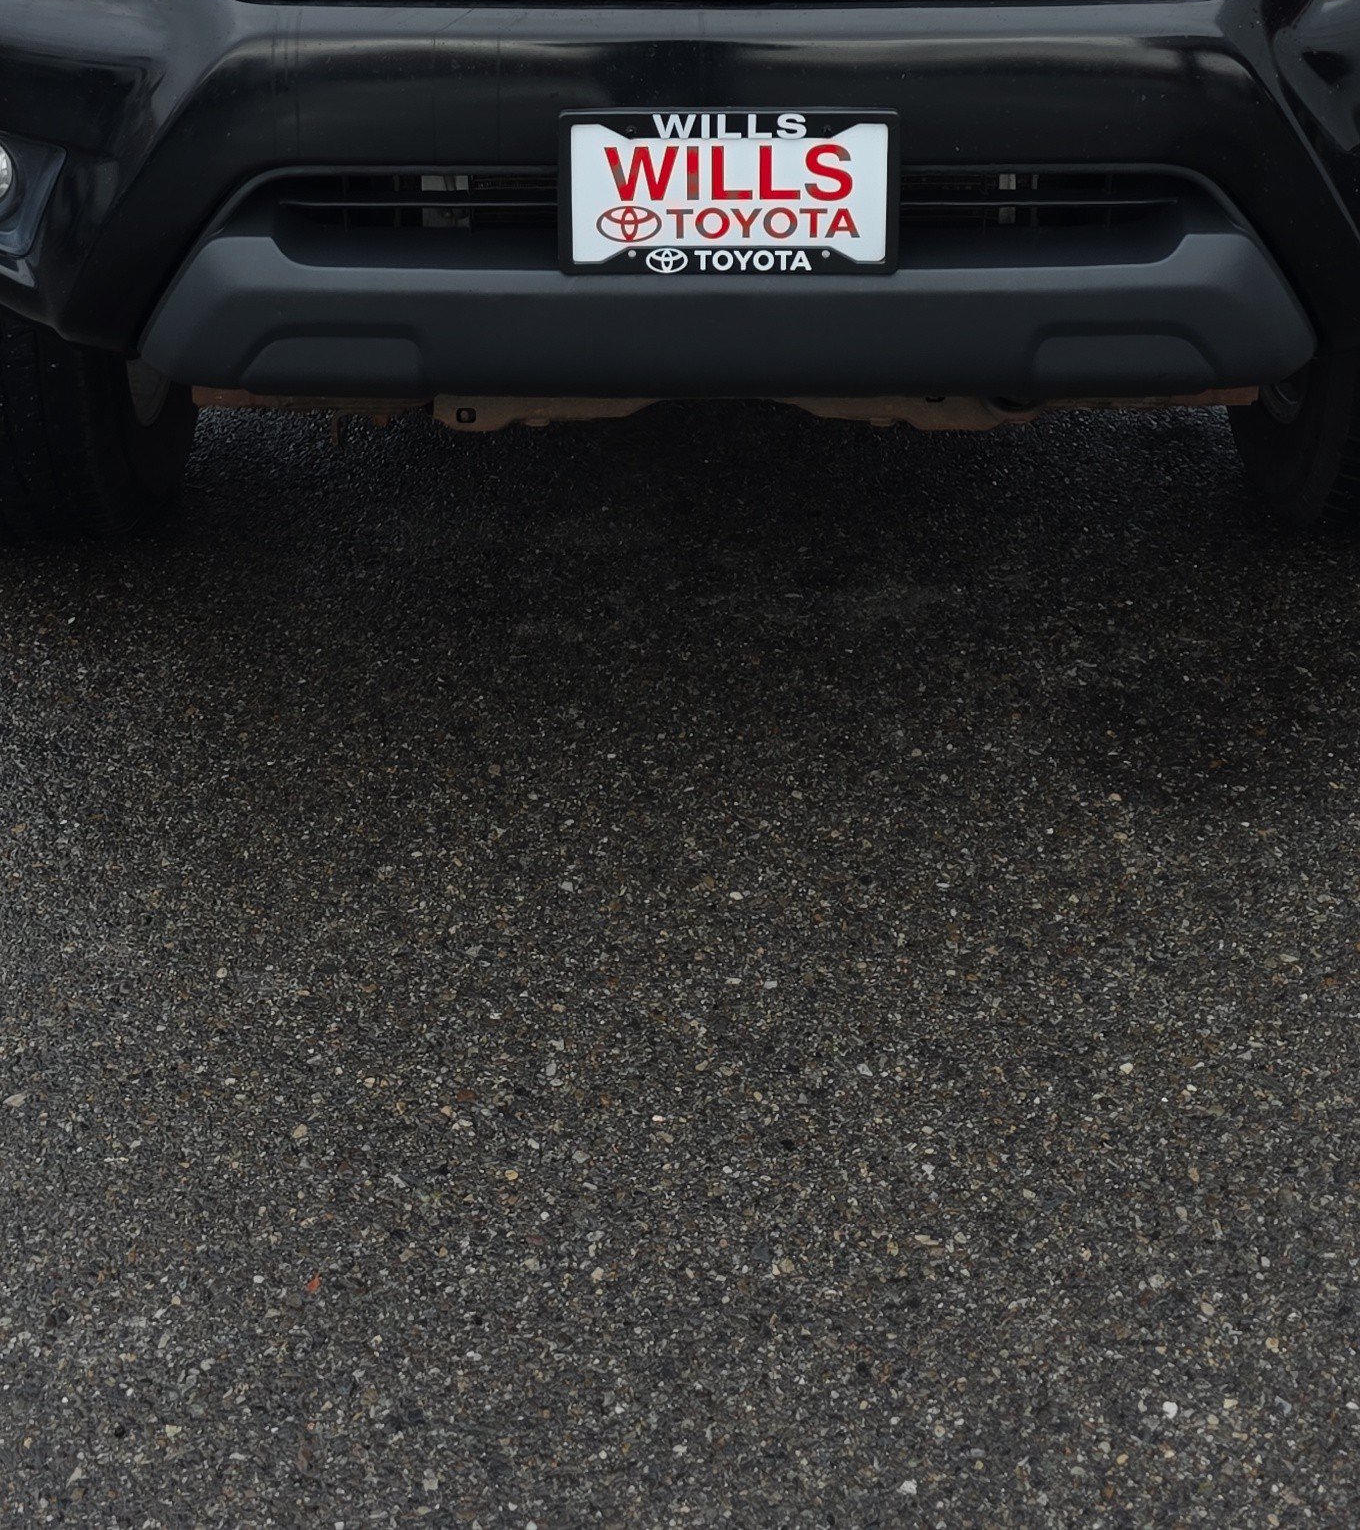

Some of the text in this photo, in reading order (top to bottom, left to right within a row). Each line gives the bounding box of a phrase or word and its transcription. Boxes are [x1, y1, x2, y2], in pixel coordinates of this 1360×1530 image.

[653, 114, 808, 139] WILLS
[604, 144, 854, 201] WILLS
[666, 207, 860, 239] TOYOTA
[693, 250, 812, 271] TOYOTA
